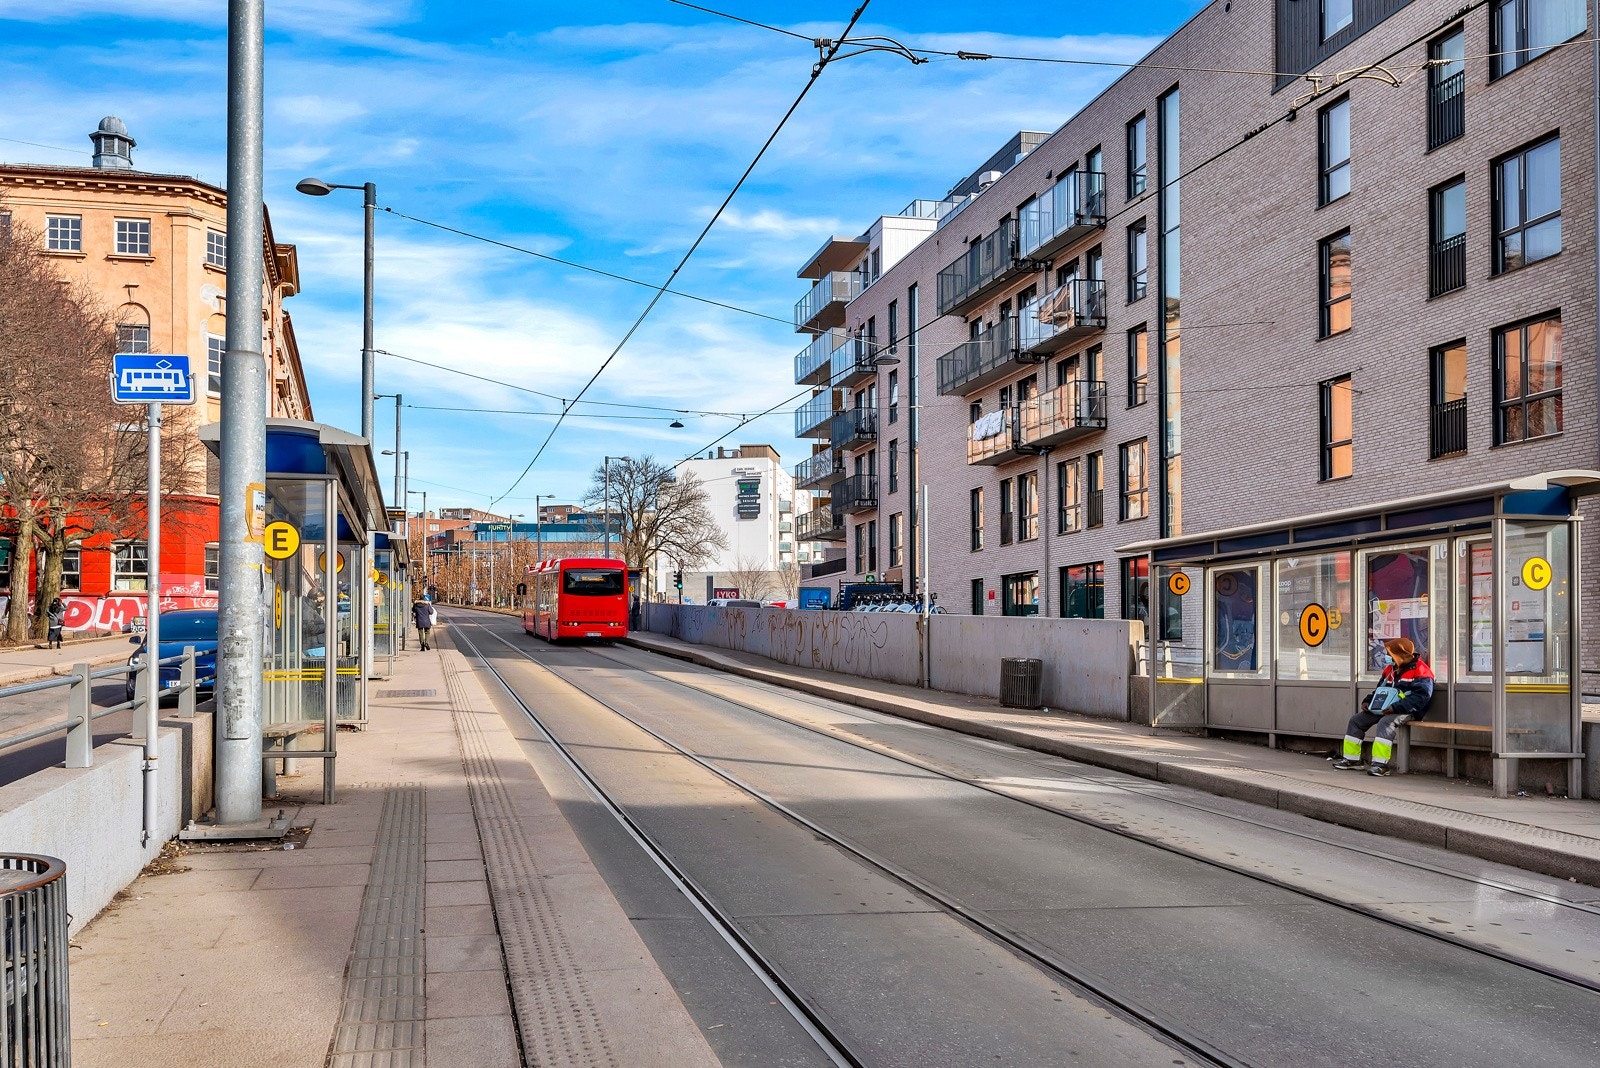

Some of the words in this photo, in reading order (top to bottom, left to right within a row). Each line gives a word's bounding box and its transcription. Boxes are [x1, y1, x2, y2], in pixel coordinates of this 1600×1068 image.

[272, 529, 288, 551] E
[1531, 563, 1544, 583] C
[1174, 577, 1184, 590] C
[716, 591, 737, 599] LYKO
[1307, 612, 1320, 637] C
